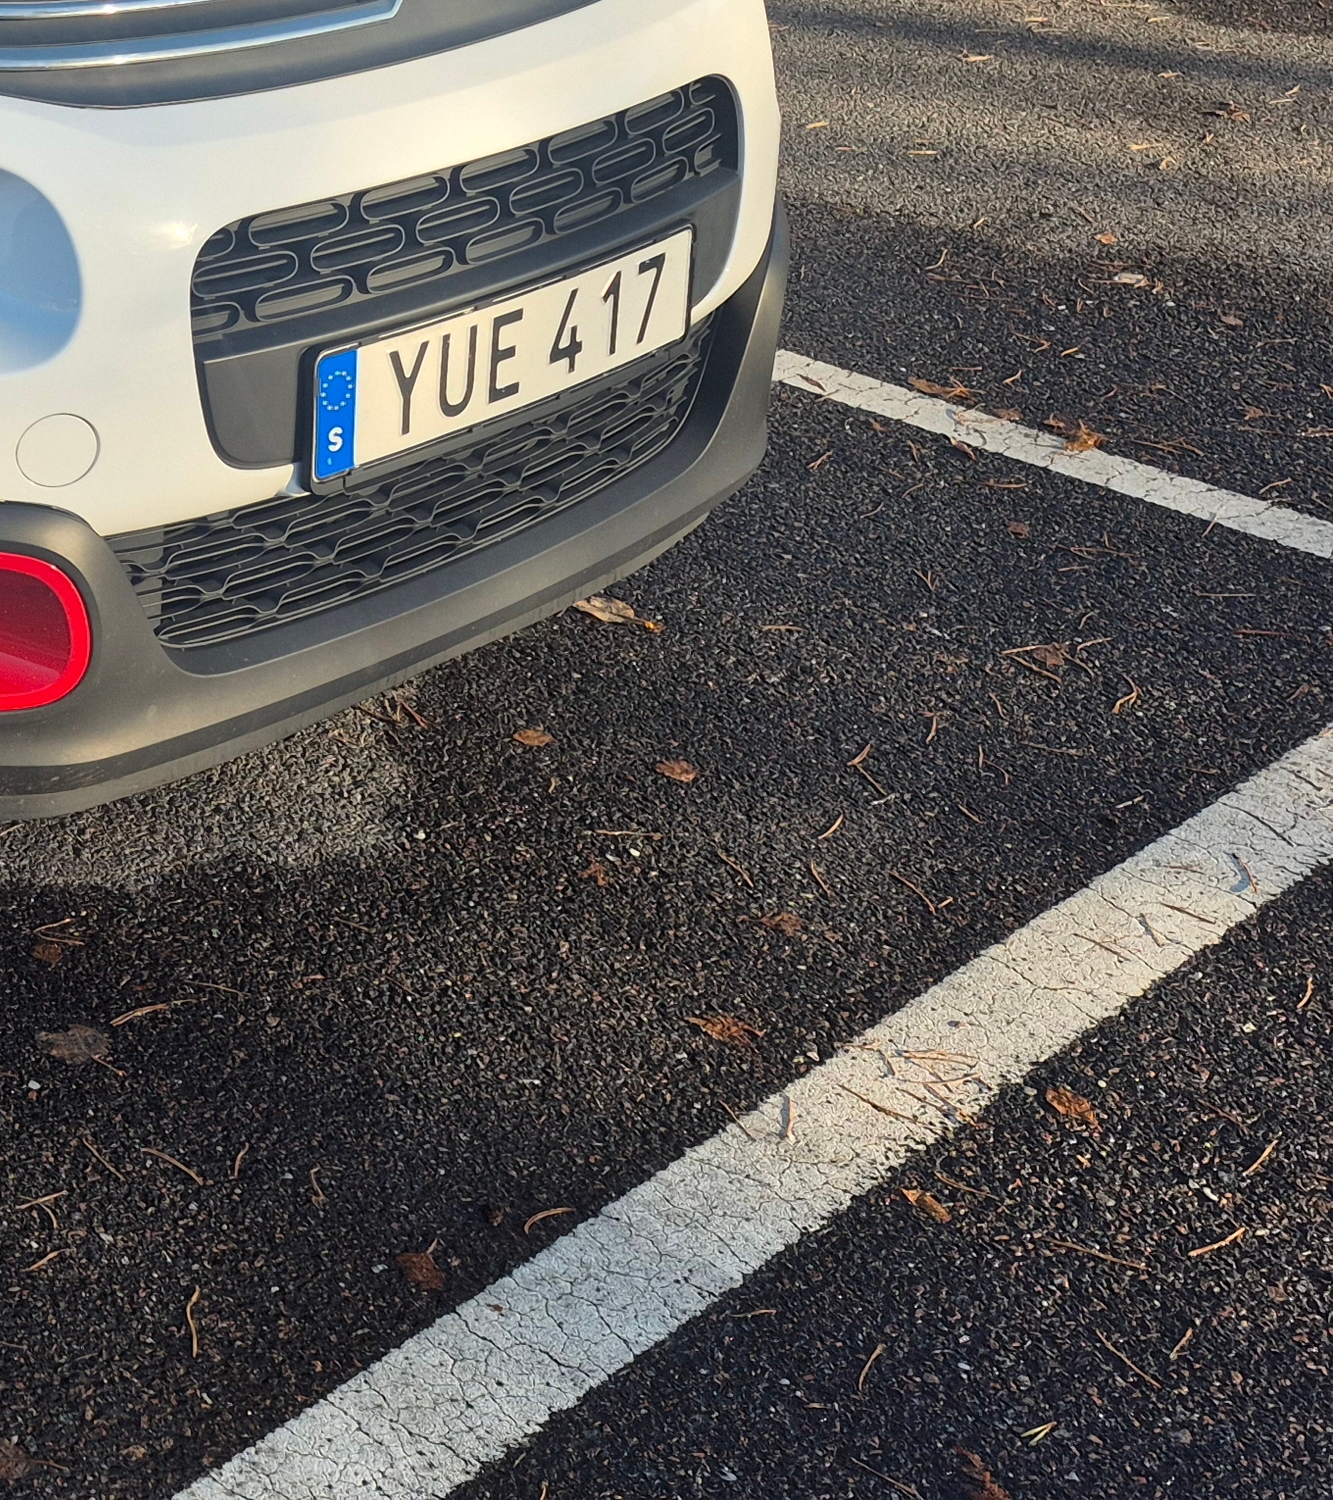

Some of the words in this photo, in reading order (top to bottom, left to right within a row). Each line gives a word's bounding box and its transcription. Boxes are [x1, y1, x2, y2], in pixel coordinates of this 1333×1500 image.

[388, 307, 524, 435] YUE
[549, 252, 667, 373] 417
[328, 426, 343, 452] S
